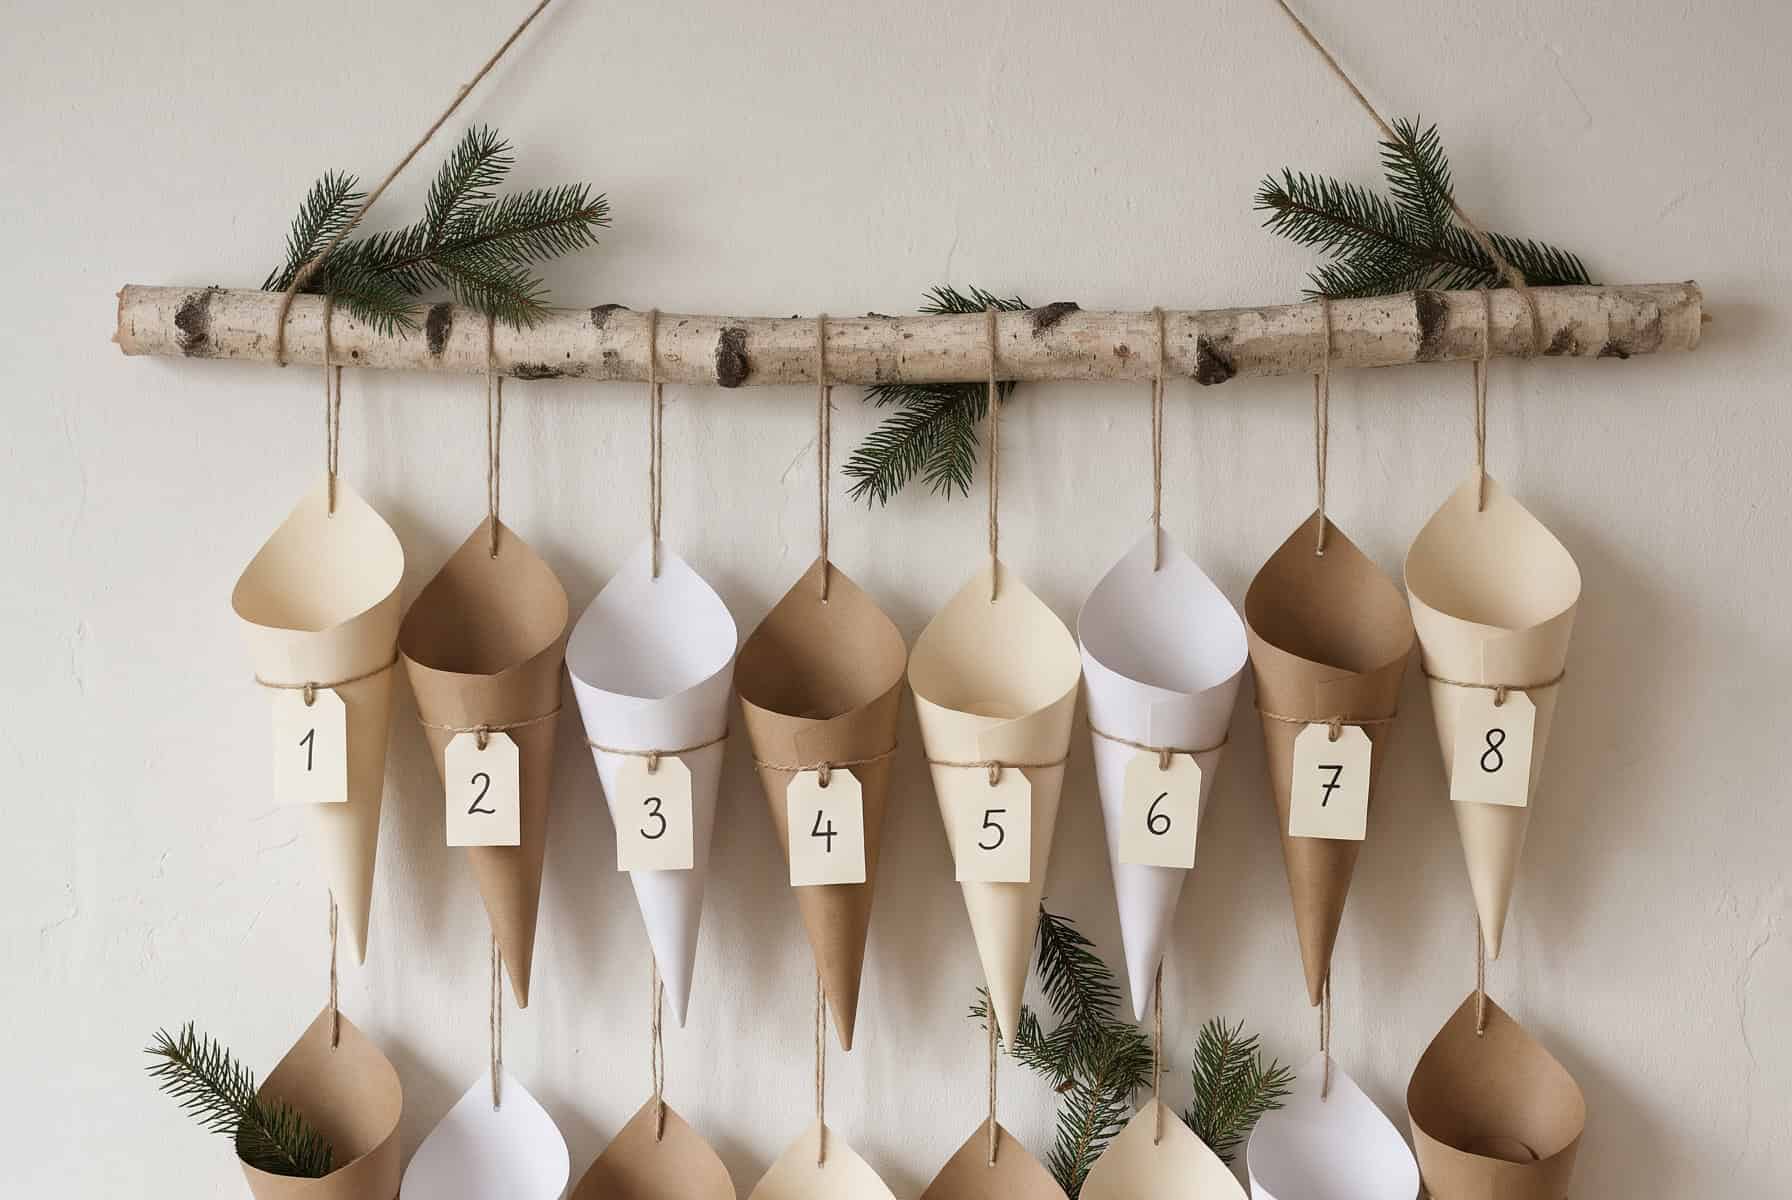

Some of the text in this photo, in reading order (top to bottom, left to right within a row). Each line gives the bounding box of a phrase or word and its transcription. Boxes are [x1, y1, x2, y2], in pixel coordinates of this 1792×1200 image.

[299, 728, 315, 772] 1
[1480, 727, 1506, 773] 8
[467, 772, 497, 815] 2
[1317, 764, 1344, 808] 7
[640, 796, 667, 840] 3
[810, 809, 838, 853] 4
[978, 808, 1007, 851] 5
[1146, 791, 1172, 836] 6
